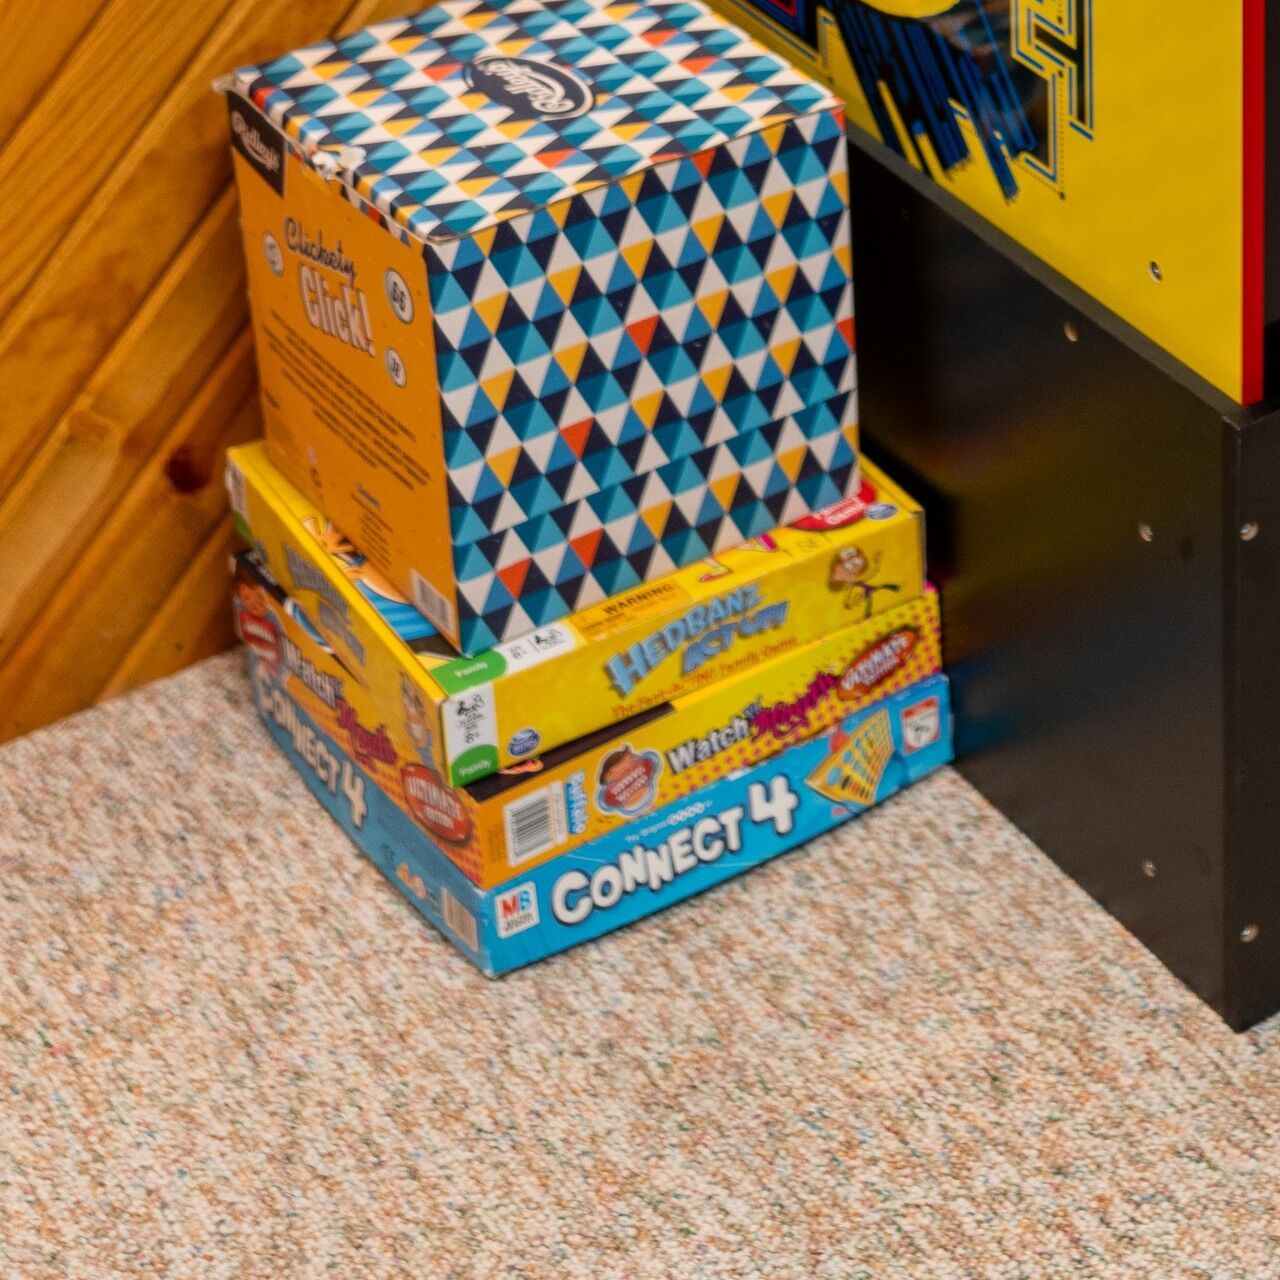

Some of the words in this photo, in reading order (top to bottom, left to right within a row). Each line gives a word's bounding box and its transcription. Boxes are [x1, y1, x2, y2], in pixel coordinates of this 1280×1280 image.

[603, 584, 674, 615] WARNING
[667, 717, 748, 775] Watch
[551, 806, 743, 924] CONNECT
[749, 776, 799, 835] 4
